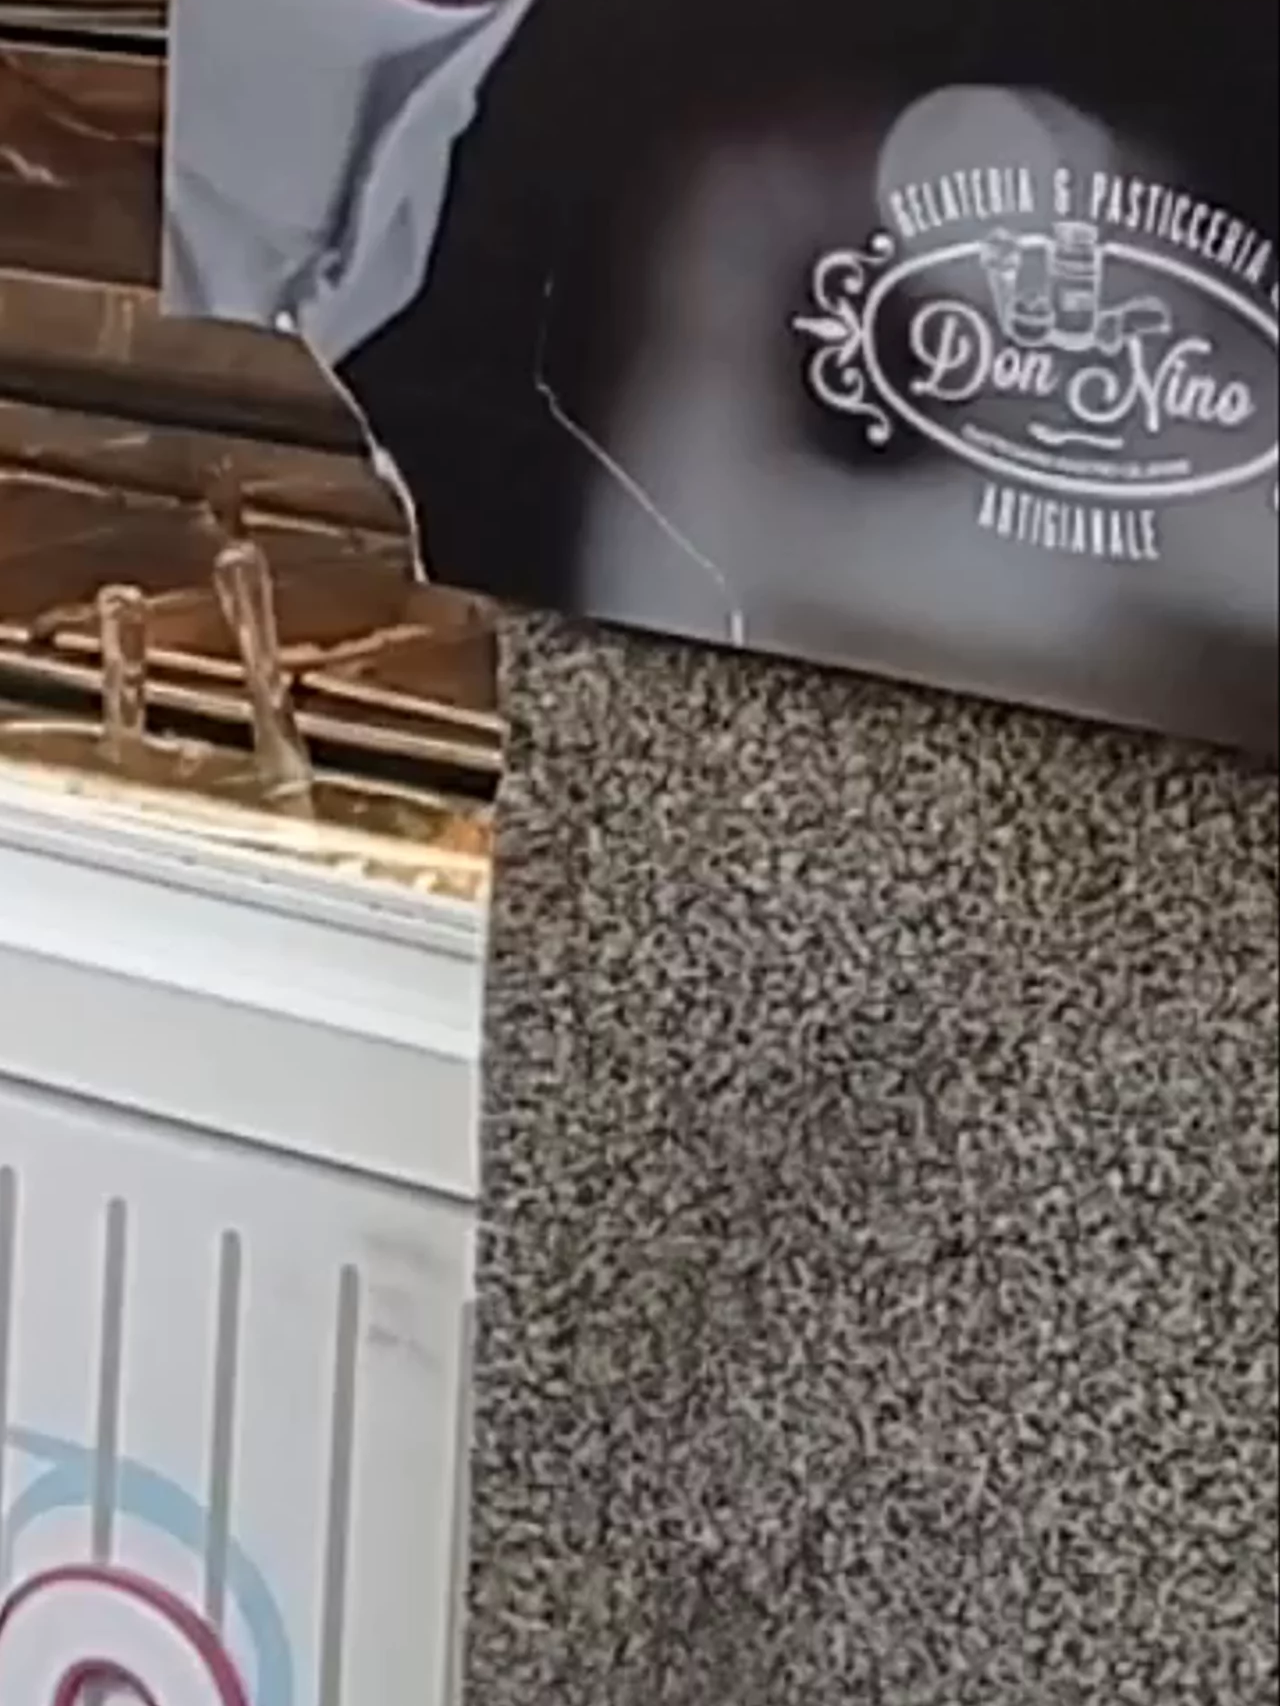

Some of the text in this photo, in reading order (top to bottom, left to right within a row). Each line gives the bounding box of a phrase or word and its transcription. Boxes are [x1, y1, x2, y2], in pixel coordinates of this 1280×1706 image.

[890, 167, 1035, 238] GELATERIA
[1089, 171, 1274, 284] PASTICCERIA
[909, 299, 1256, 433] Don Nino
[977, 482, 1160, 561] ARTIGIANALE
